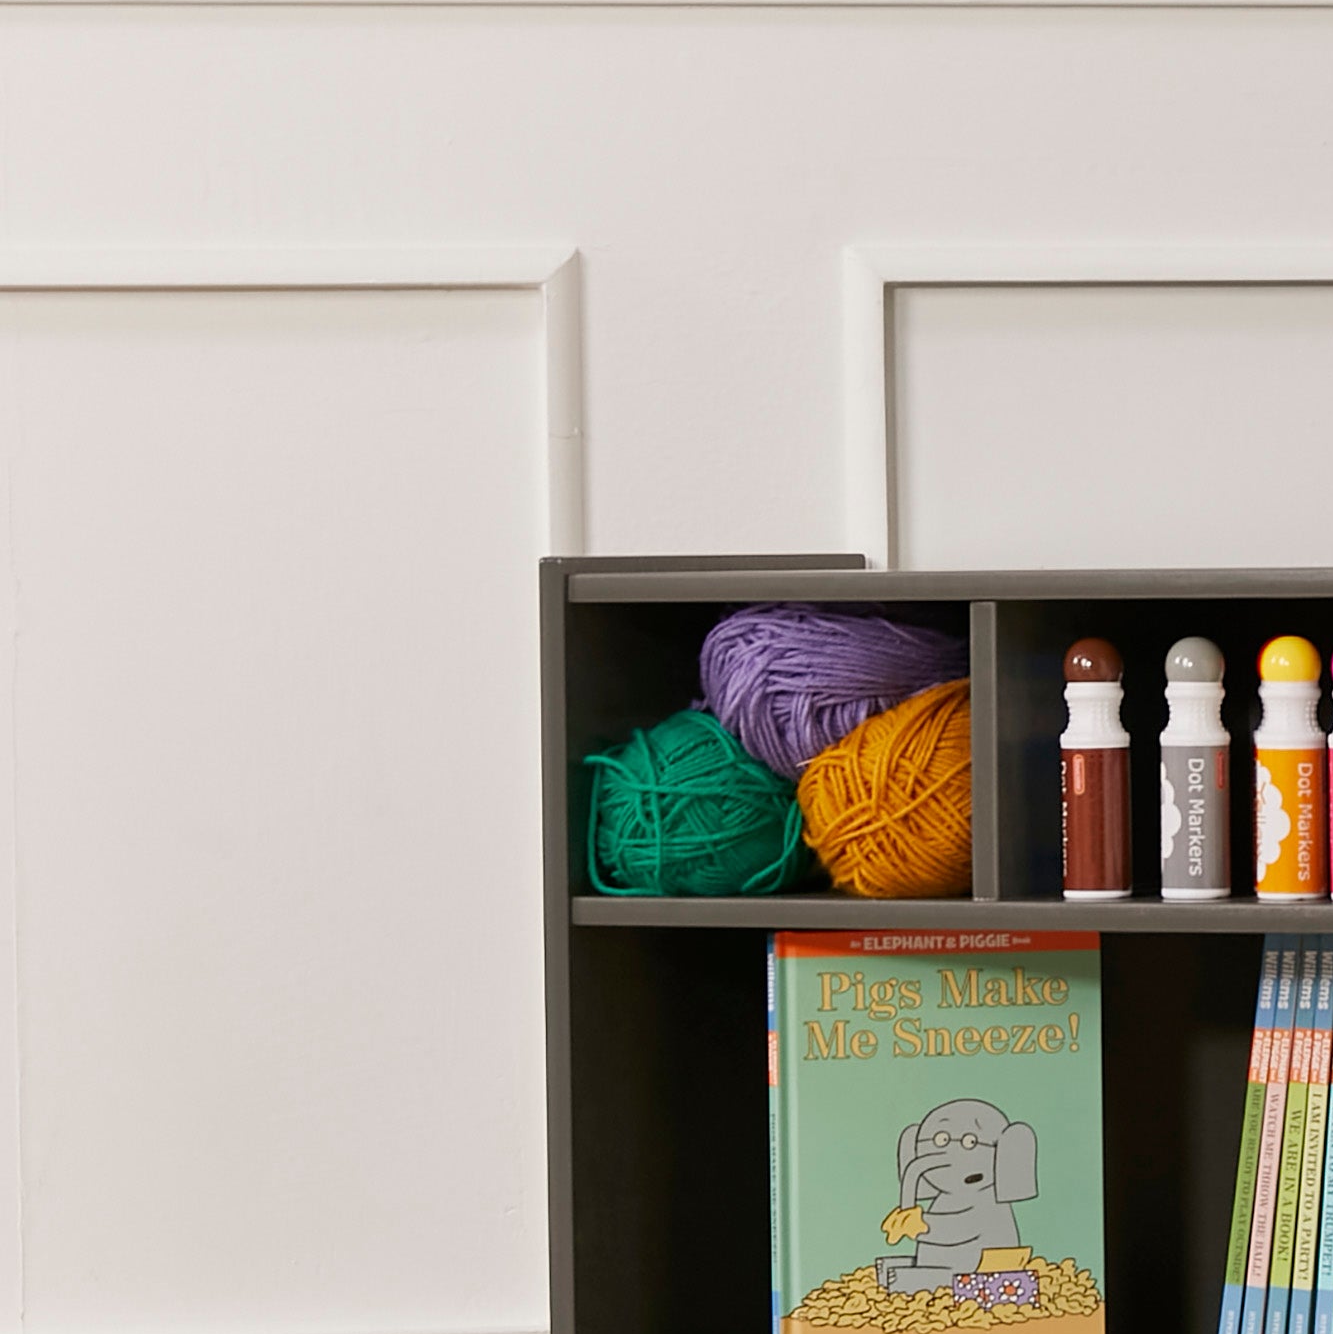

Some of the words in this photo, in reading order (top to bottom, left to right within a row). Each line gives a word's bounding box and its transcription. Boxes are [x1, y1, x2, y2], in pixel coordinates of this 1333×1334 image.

[1188, 758, 1204, 793] Dot
[1297, 763, 1313, 797] Dot
[1188, 799, 1205, 876] Markers
[1297, 804, 1313, 882] Markers
[863, 935, 945, 951] ELEPHANT
[946, 936, 957, 949] &
[959, 934, 1010, 949] PIGGIE
[817, 971, 924, 1020] Pigs
[936, 966, 1070, 1008] Make
[804, 1019, 878, 1061] Me
[893, 1012, 1080, 1058] Sneeze!
